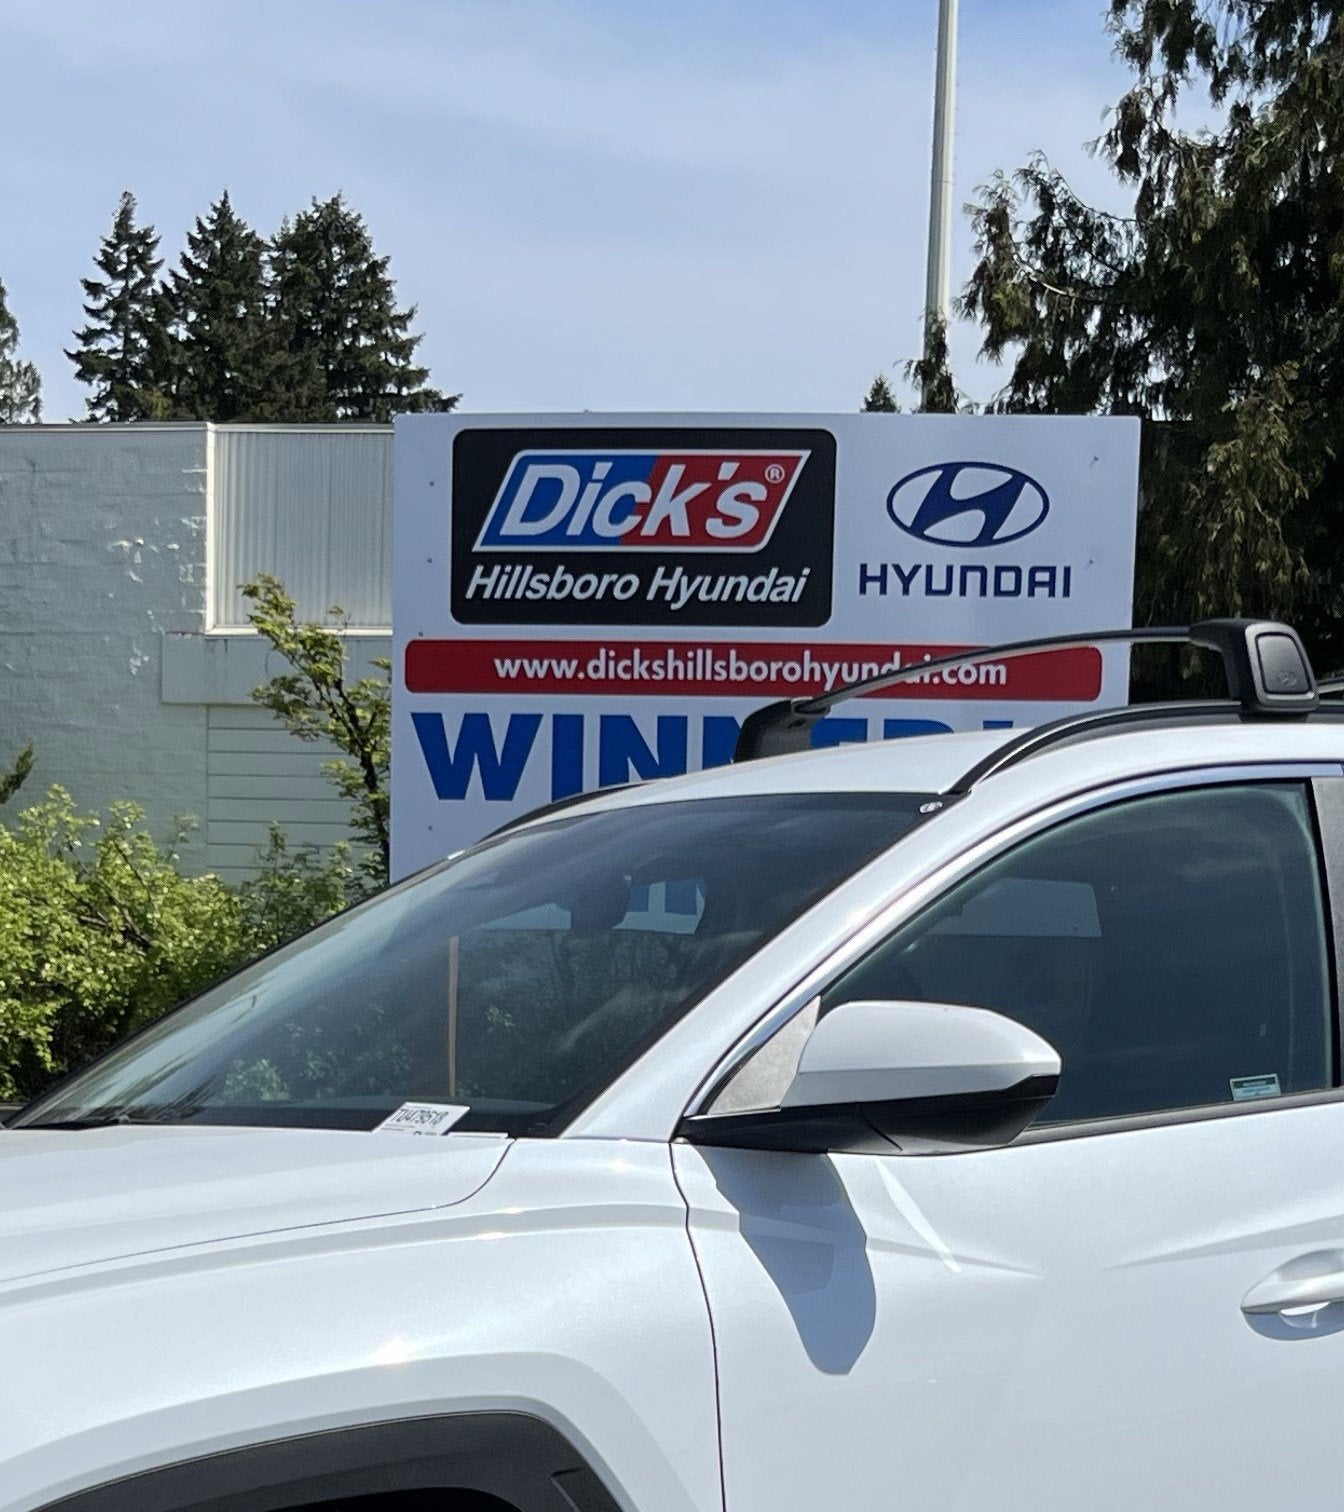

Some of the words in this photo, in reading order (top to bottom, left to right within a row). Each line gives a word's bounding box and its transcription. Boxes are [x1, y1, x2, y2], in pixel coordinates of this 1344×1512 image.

[465, 566, 640, 601] Hillsboro
[647, 565, 811, 609] Hyundai
[859, 563, 1071, 599] HYUNDAI
